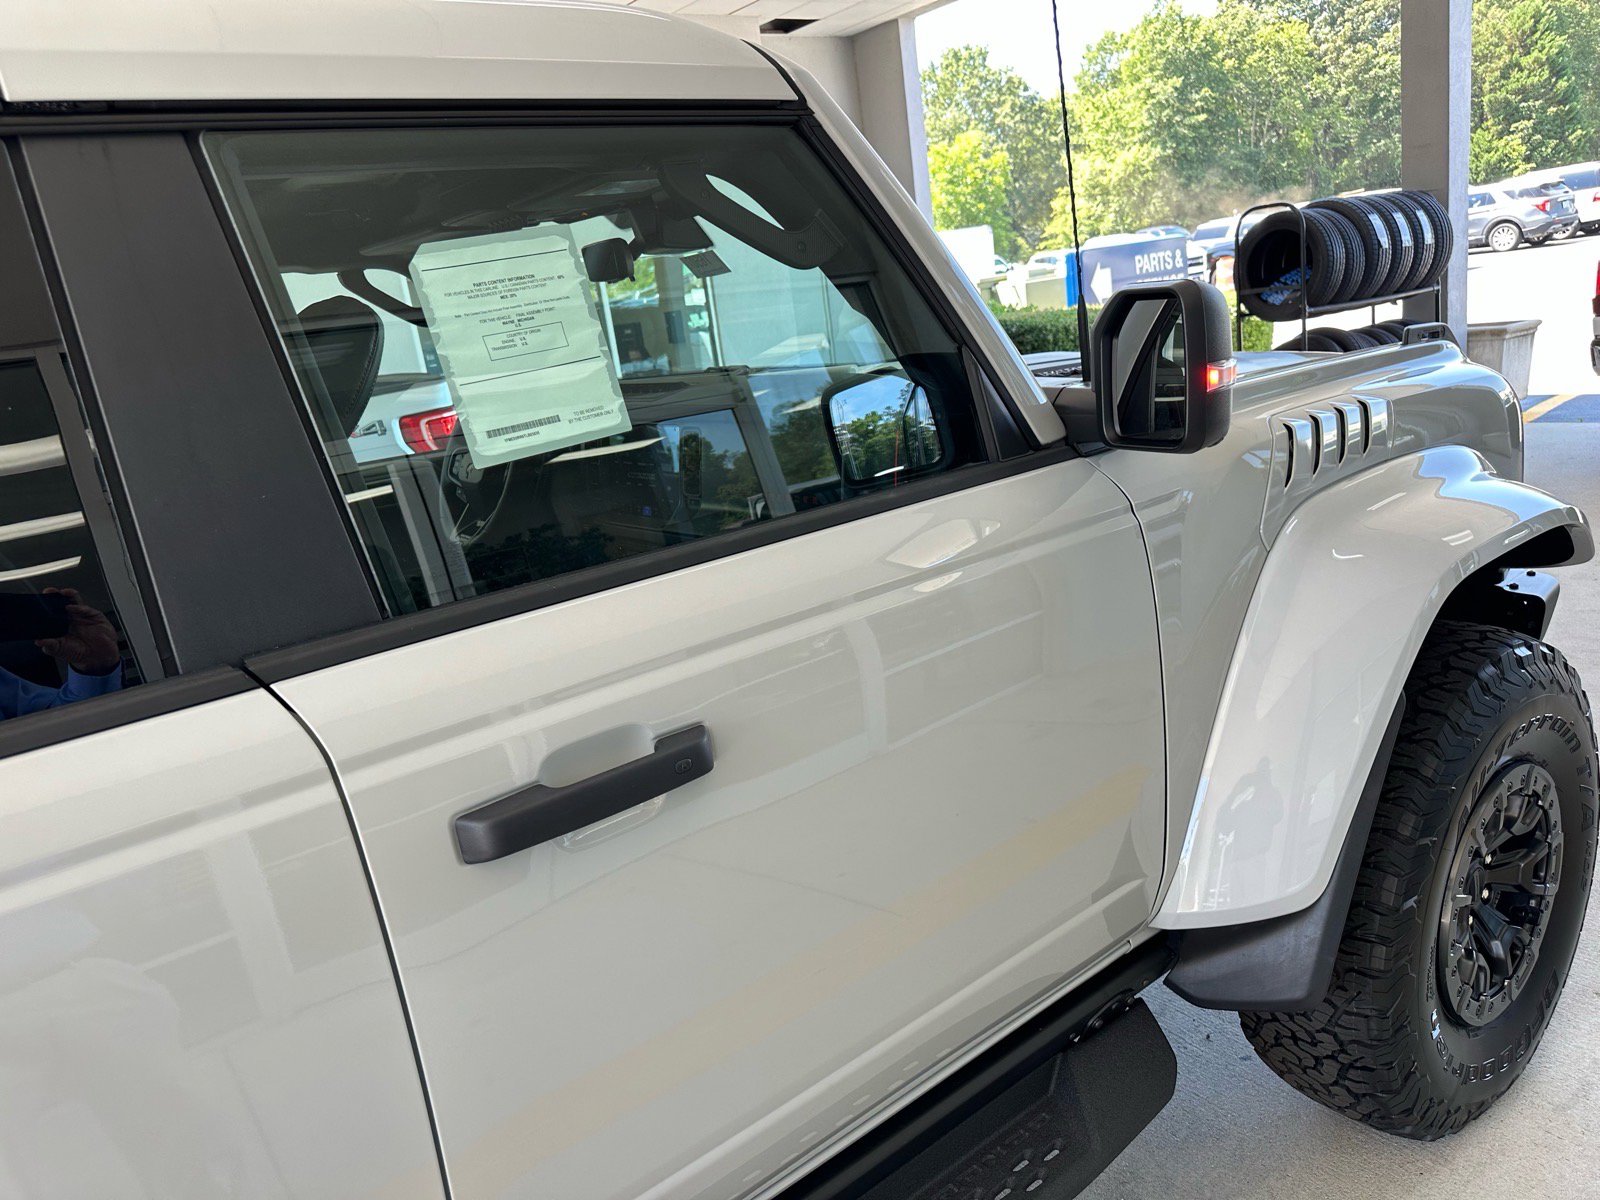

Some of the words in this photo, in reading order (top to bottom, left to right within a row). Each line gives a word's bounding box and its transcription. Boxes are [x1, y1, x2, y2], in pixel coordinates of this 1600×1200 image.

[1135, 249, 1174, 275] PARTS
[1175, 248, 1184, 268] &
[487, 278, 507, 286] CONTENT
[507, 274, 536, 282] INFORMATION
